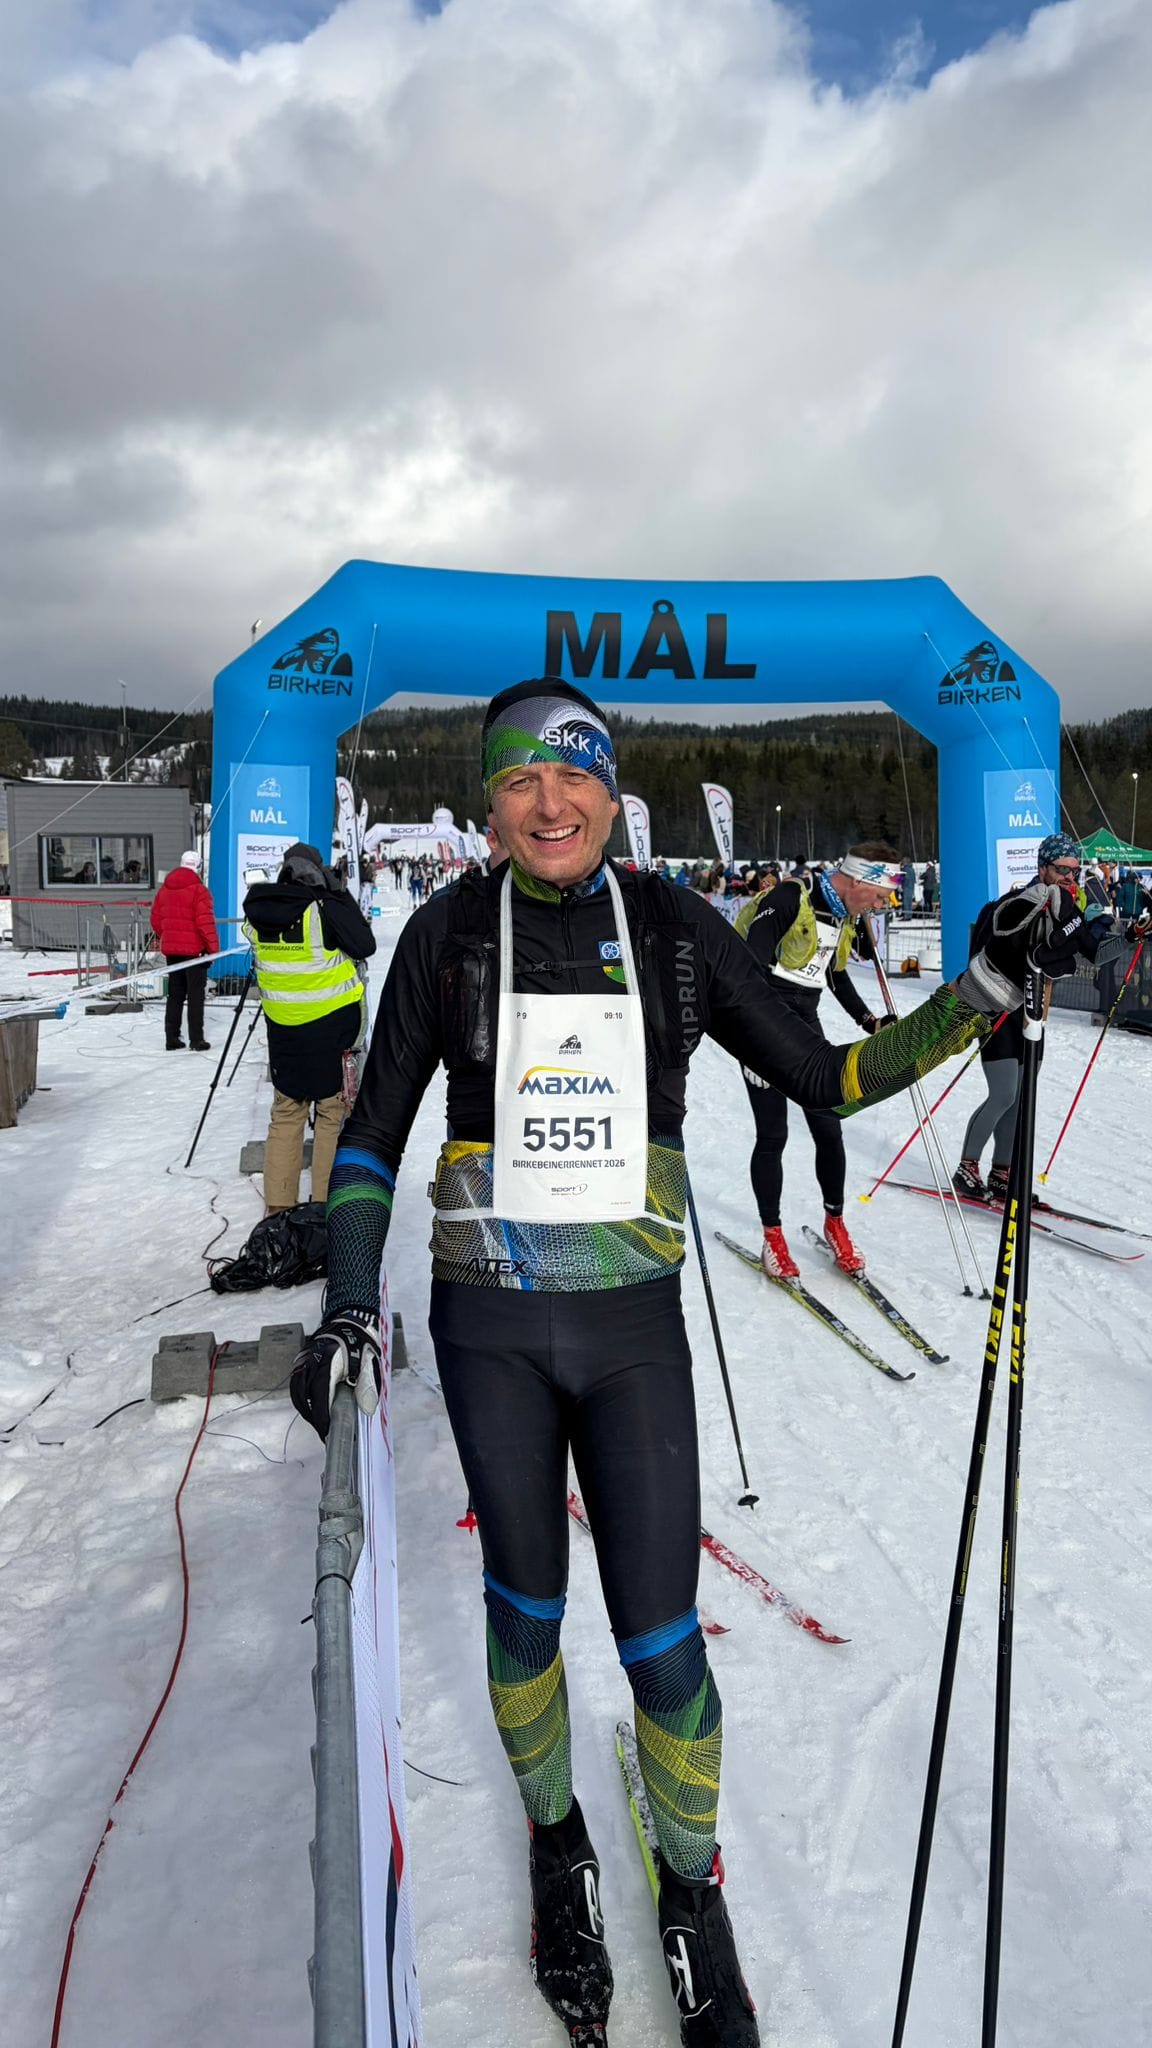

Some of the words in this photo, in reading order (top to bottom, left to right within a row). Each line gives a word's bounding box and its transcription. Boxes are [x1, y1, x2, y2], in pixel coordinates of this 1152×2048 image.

[545, 599, 757, 679] MÅL
[267, 674, 353, 697] BIRKEN
[937, 686, 1022, 705] BIRKEN
[250, 806, 288, 825] MÅL
[1008, 810, 1042, 828] MÅL
[675, 940, 700, 1054] KIPRUN
[1025, 974, 1035, 1010] LEKI
[604, 1012, 623, 1020] 09:10
[523, 1115, 613, 1152] 5551
[512, 1159, 602, 1169] BIRKEBEINERRENNET
[604, 1159, 626, 1168] 2026
